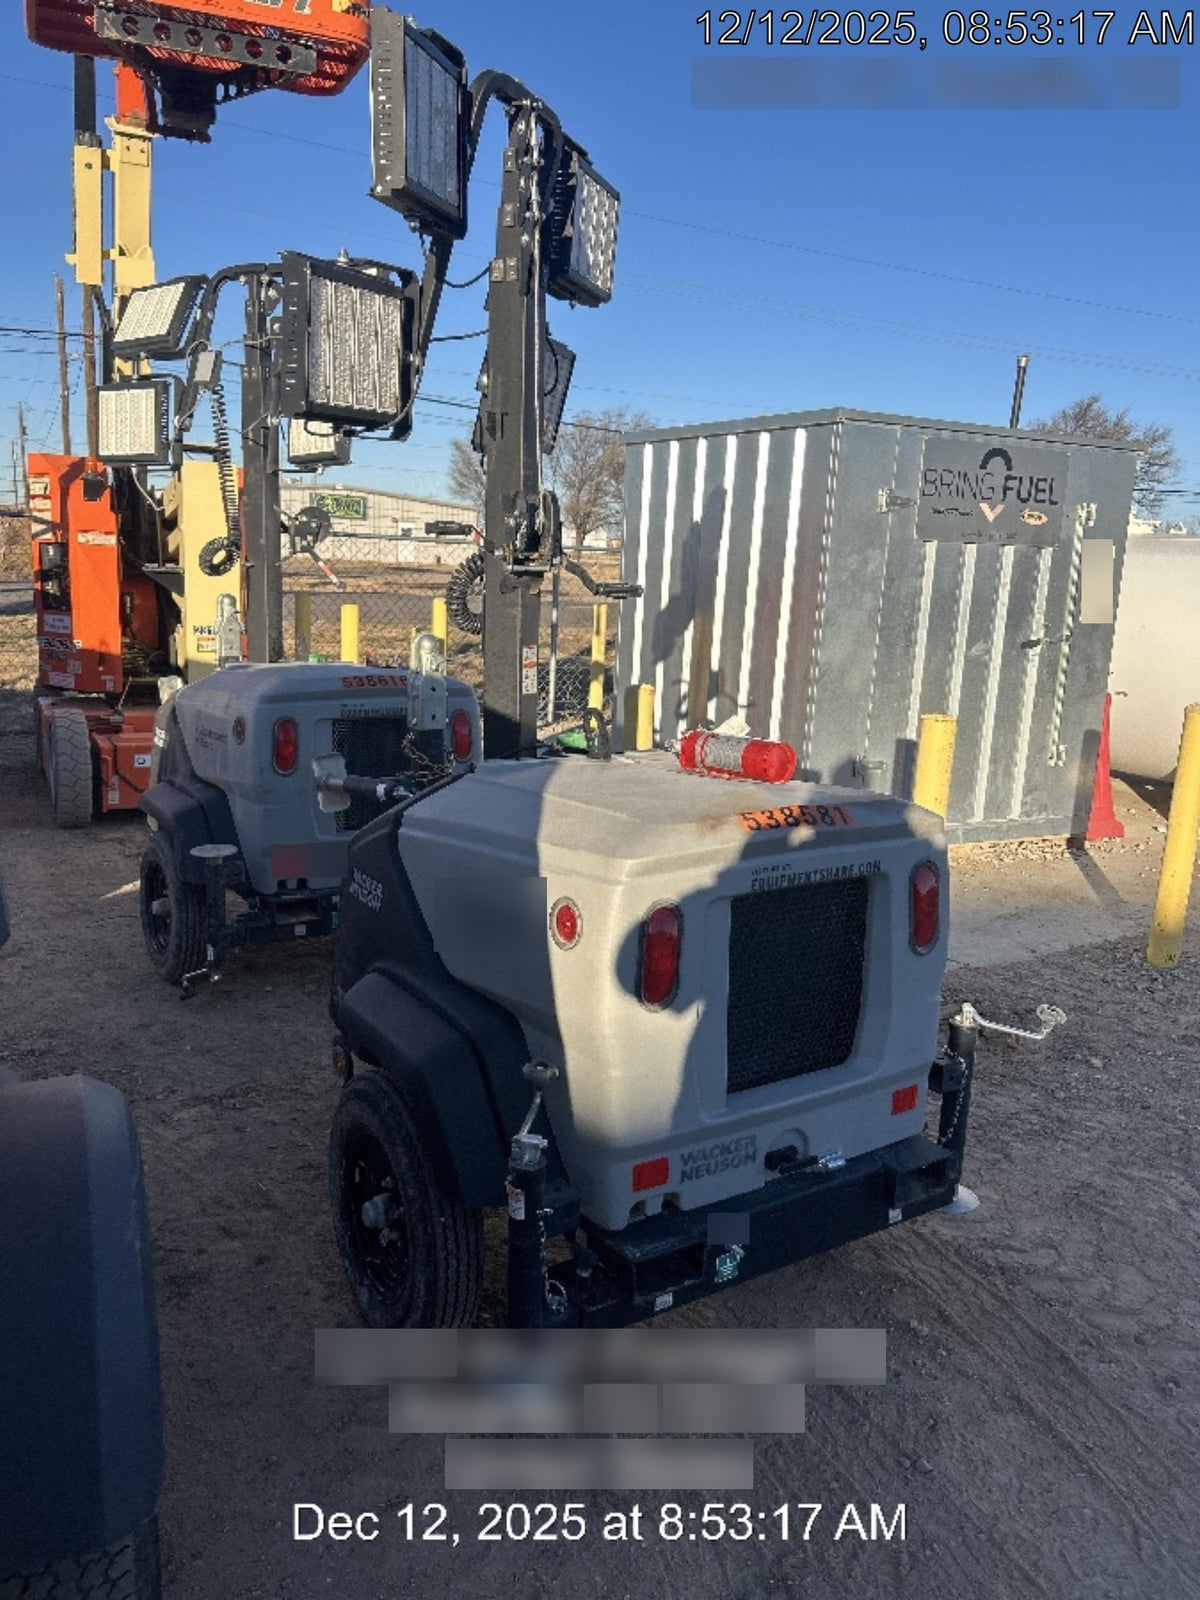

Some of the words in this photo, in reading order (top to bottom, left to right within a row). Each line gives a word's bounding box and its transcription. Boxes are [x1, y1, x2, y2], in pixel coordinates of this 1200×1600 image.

[922, 468, 995, 501] BRING
[1001, 473, 1059, 505] FUEL
[741, 804, 850, 831] 538581
[680, 1134, 757, 1166] WACKER
[680, 1149, 758, 1184] NEUSON
